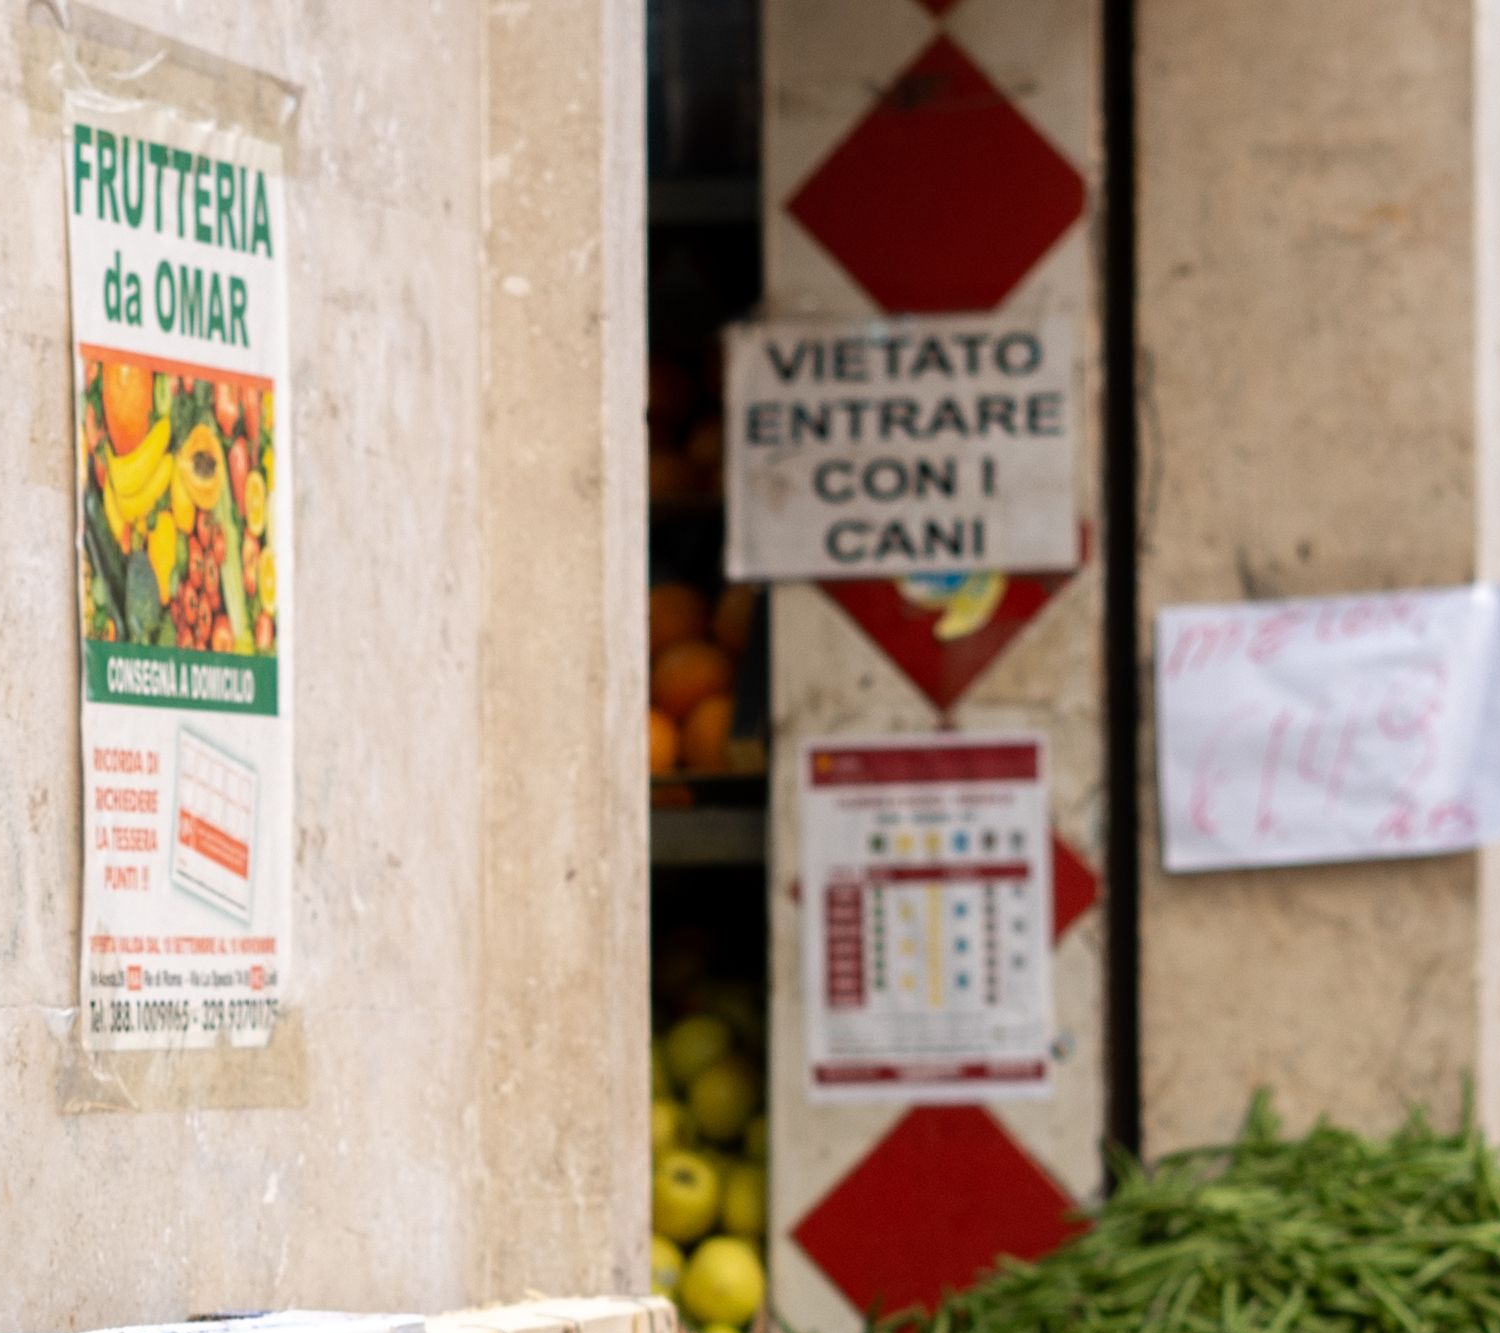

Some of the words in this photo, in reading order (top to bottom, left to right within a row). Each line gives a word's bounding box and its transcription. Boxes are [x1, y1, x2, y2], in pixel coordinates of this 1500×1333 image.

[74, 123, 272, 259] FRUTTERIA
[104, 250, 142, 328] da
[155, 259, 249, 348] OMAR
[765, 331, 1043, 384] VIETATO
[746, 391, 1065, 446] ENTRARE
[813, 456, 957, 504] CON
[981, 452, 995, 498] I
[824, 517, 985, 564] CANI
[179, 663, 188, 697] A
[191, 663, 255, 704] DOMICILIO
[93, 747, 142, 774] RICORDA
[147, 749, 159, 775] DI
[96, 787, 157, 814] RICHIEDERE
[112, 827, 157, 851] TESSERA
[105, 866, 138, 891] PUNTI
